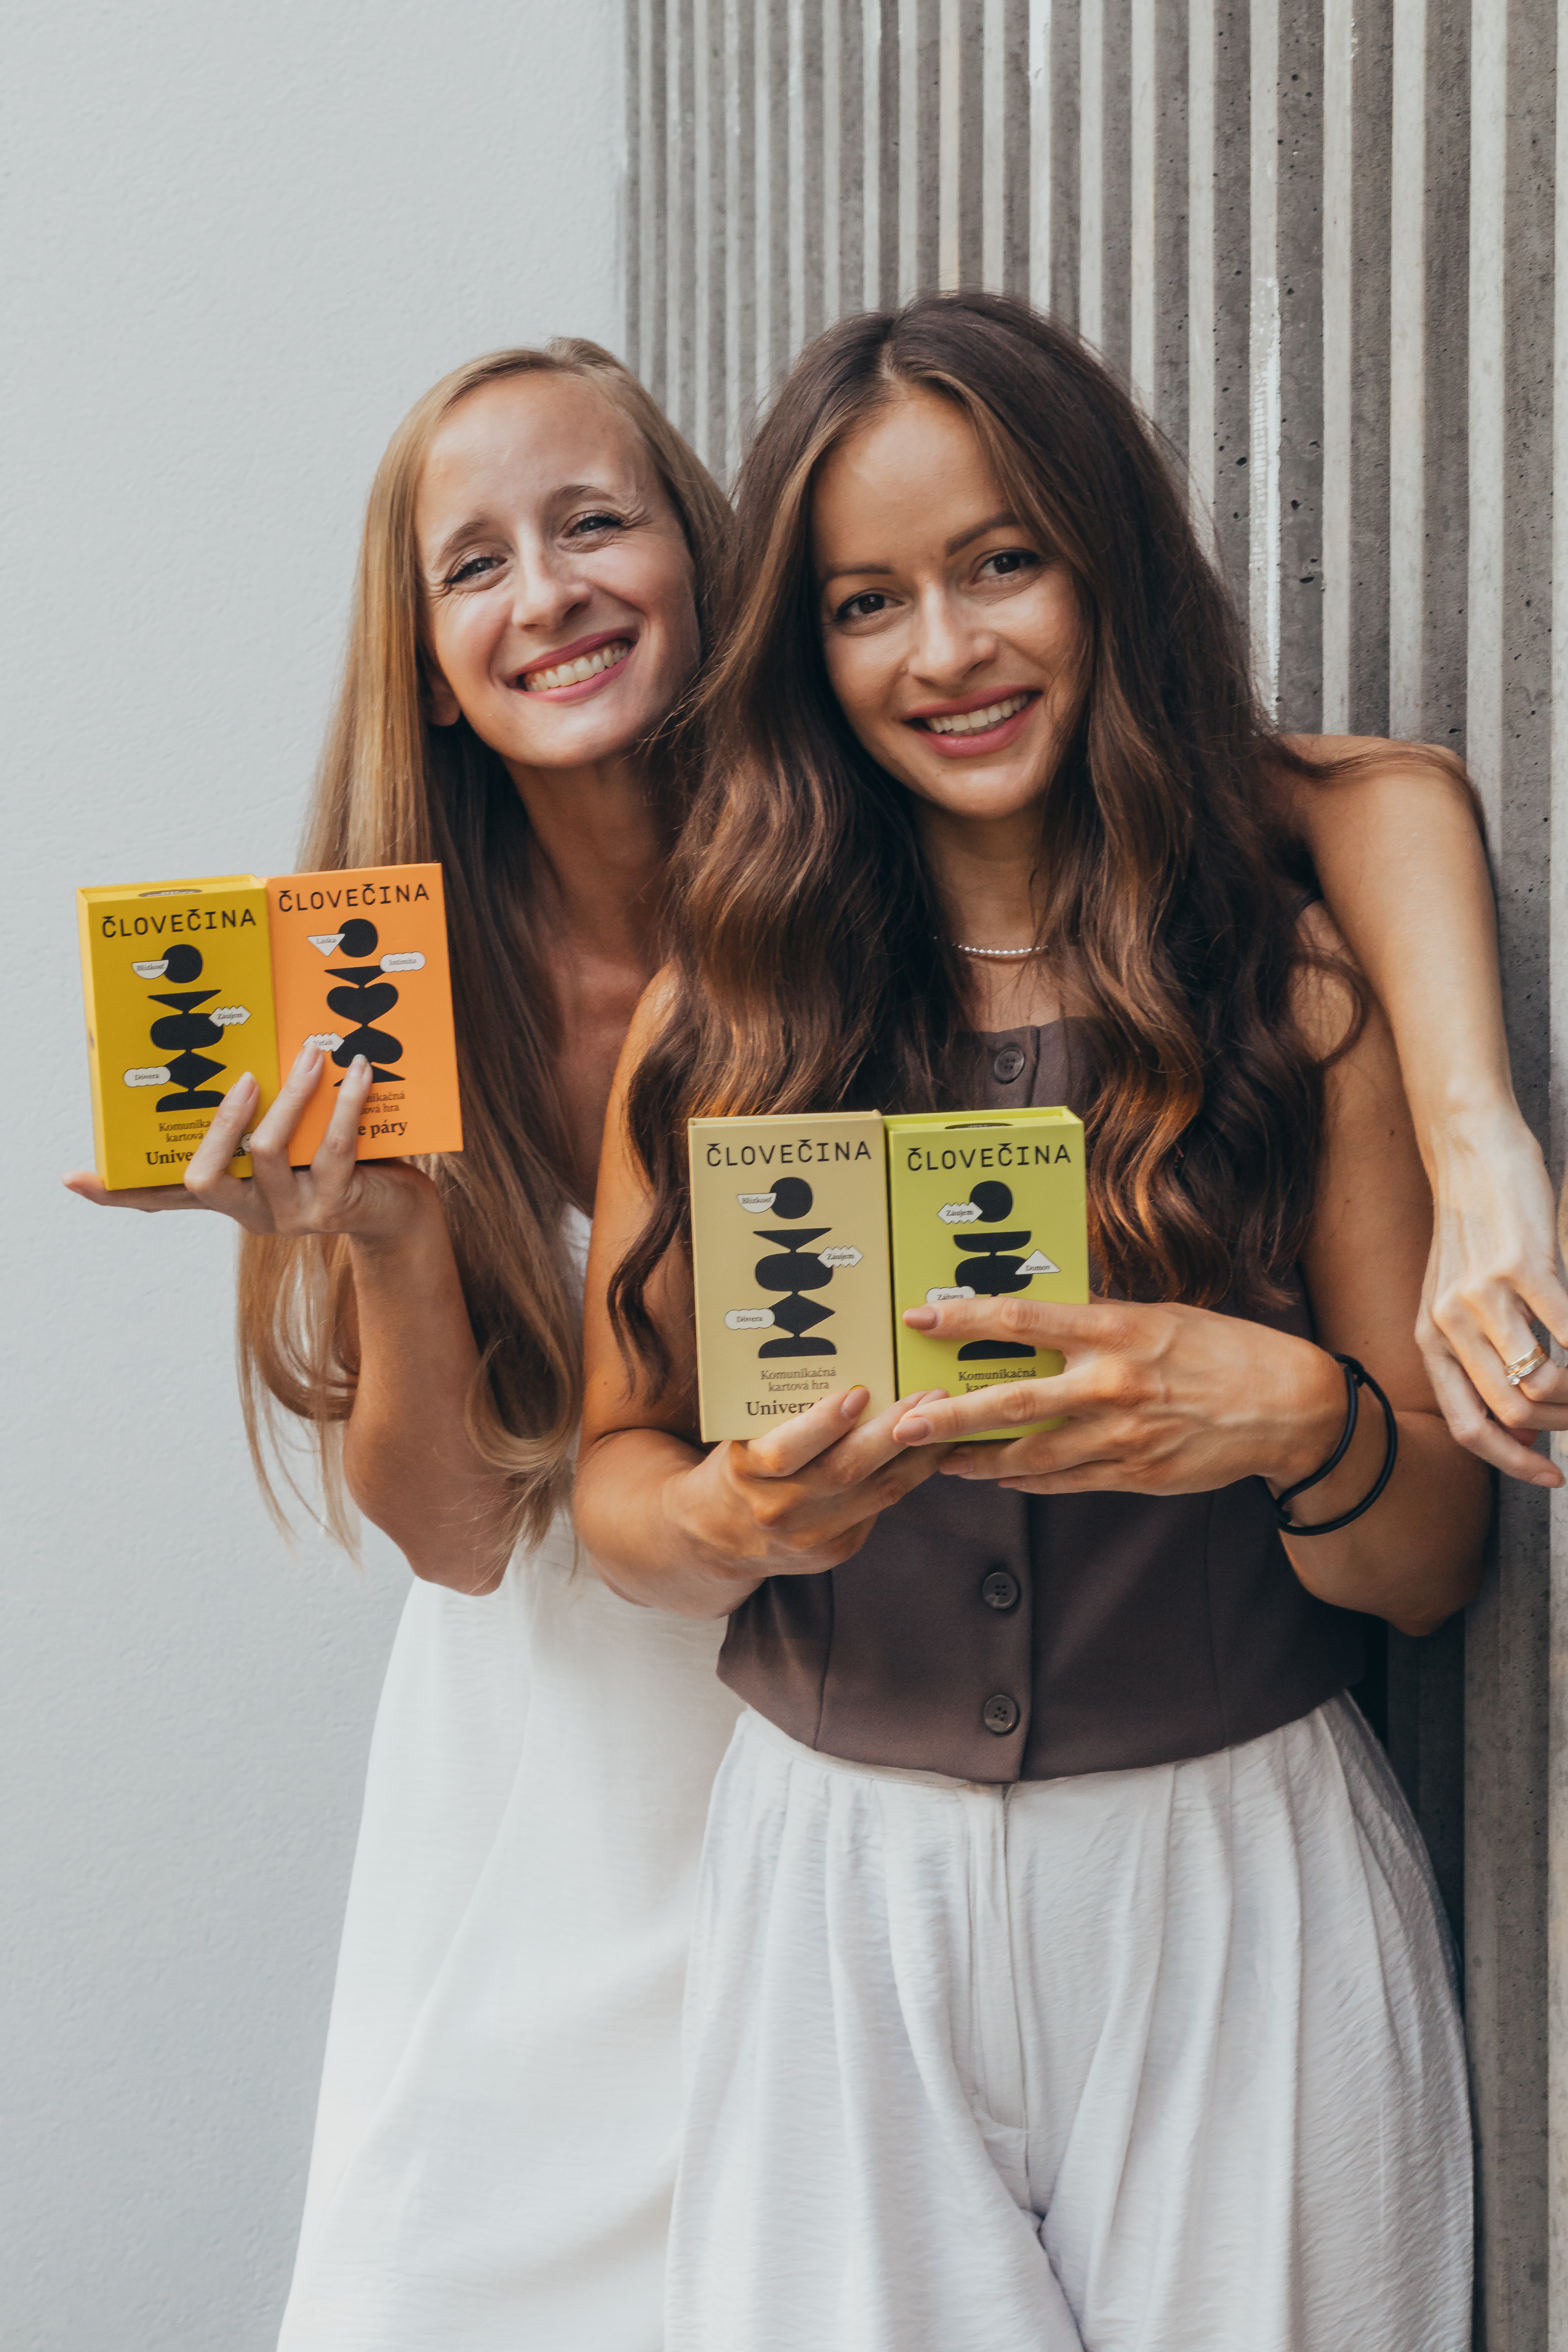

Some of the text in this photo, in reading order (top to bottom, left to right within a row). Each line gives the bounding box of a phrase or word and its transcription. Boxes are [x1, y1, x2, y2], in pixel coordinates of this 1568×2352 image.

[279, 884, 430, 912] ČLOVEČINA
[102, 909, 256, 938] ČLOVEČINA
[382, 1103, 400, 1112] hra
[158, 1119, 211, 1132] Komunika
[370, 1119, 408, 1139] páry
[706, 1139, 872, 1167] ČLOVEČINA
[907, 1143, 1072, 1171] ČLOVEČINA
[760, 1367, 837, 1380] Komunikačná
[958, 1367, 1037, 1381] Komunikačná
[768, 1379, 830, 1392] kartová hra
